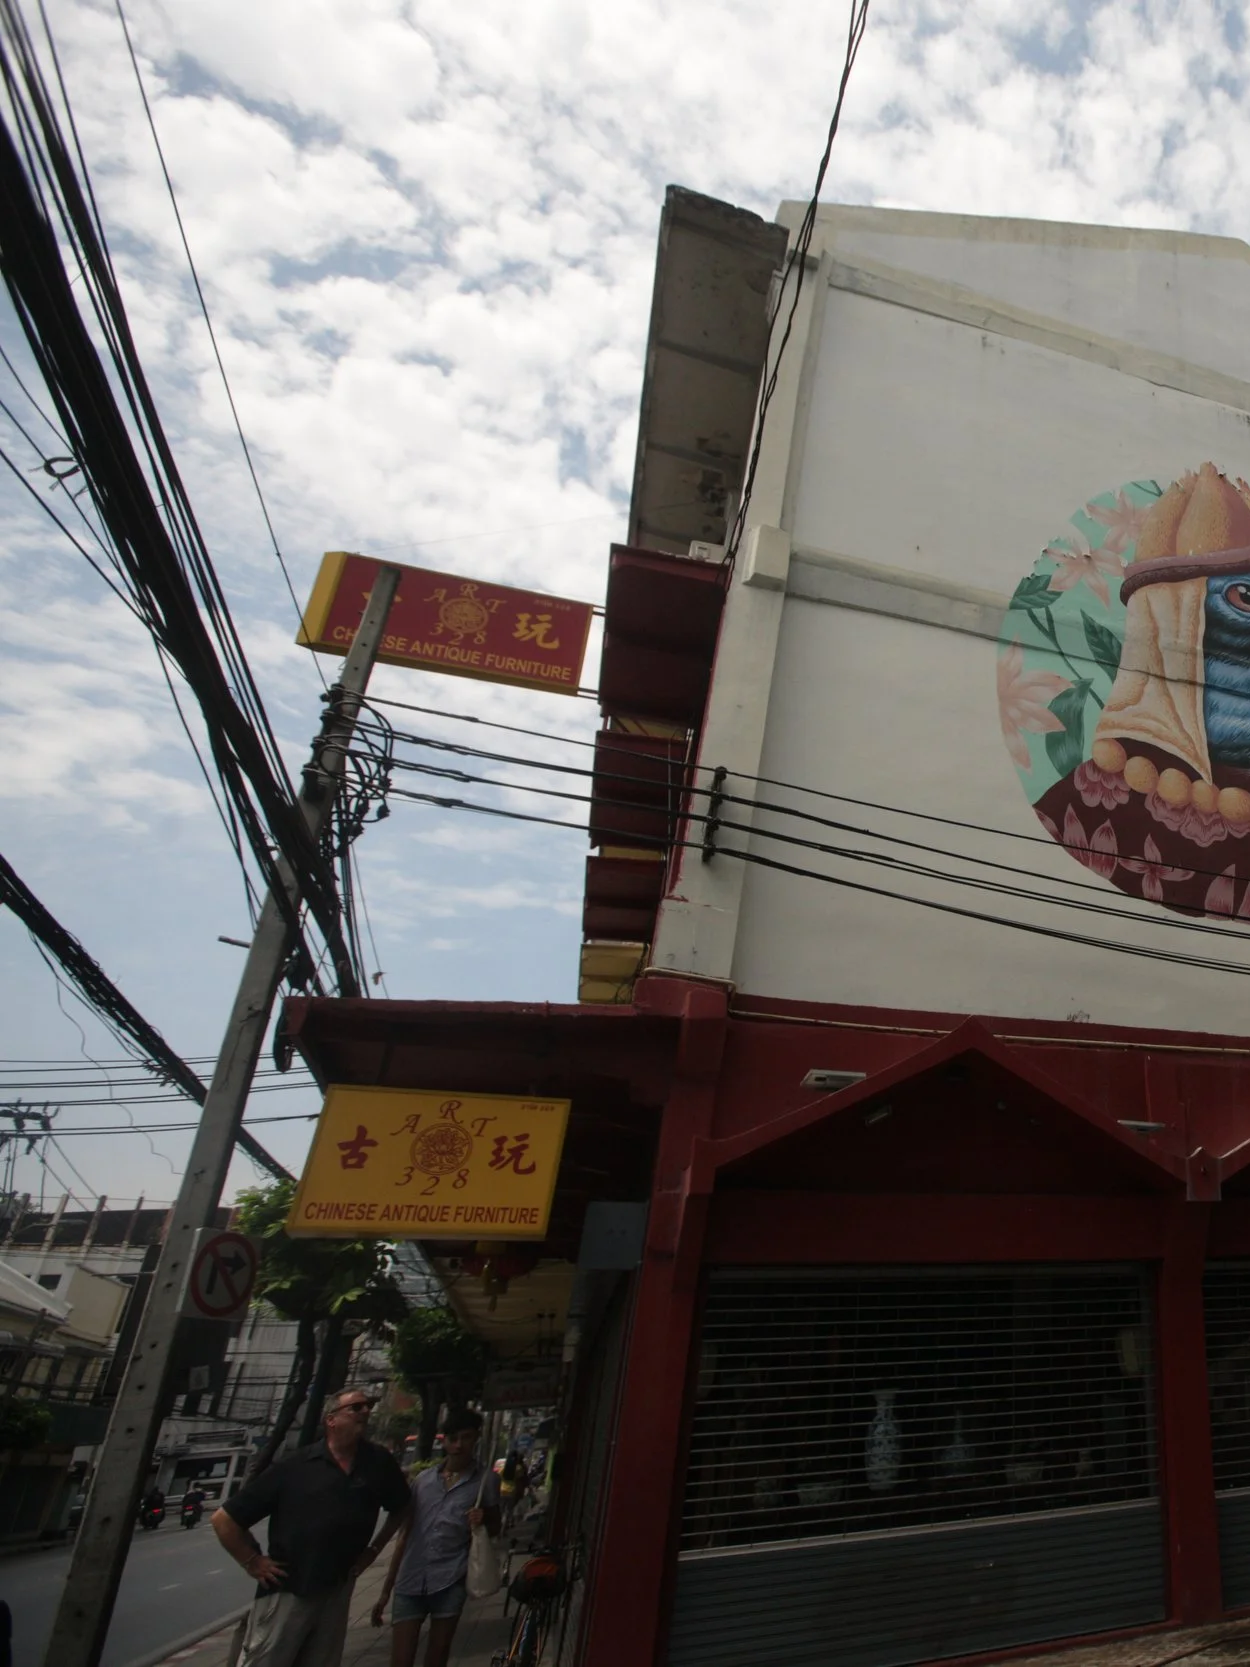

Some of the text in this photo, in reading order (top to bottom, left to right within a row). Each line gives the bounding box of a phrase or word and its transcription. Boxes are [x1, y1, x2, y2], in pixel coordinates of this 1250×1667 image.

[423, 582, 507, 613] ART
[429, 622, 487, 645] 328
[512, 612, 560, 649] 玩
[332, 625, 572, 681] CHSE ANTIQUE FURNITURE
[390, 1100, 497, 1138] ART
[337, 1125, 536, 1175] 古 玩
[394, 1166, 470, 1196] 328
[304, 1202, 539, 1224] CHINESE ANTIQUE FURNITURE
